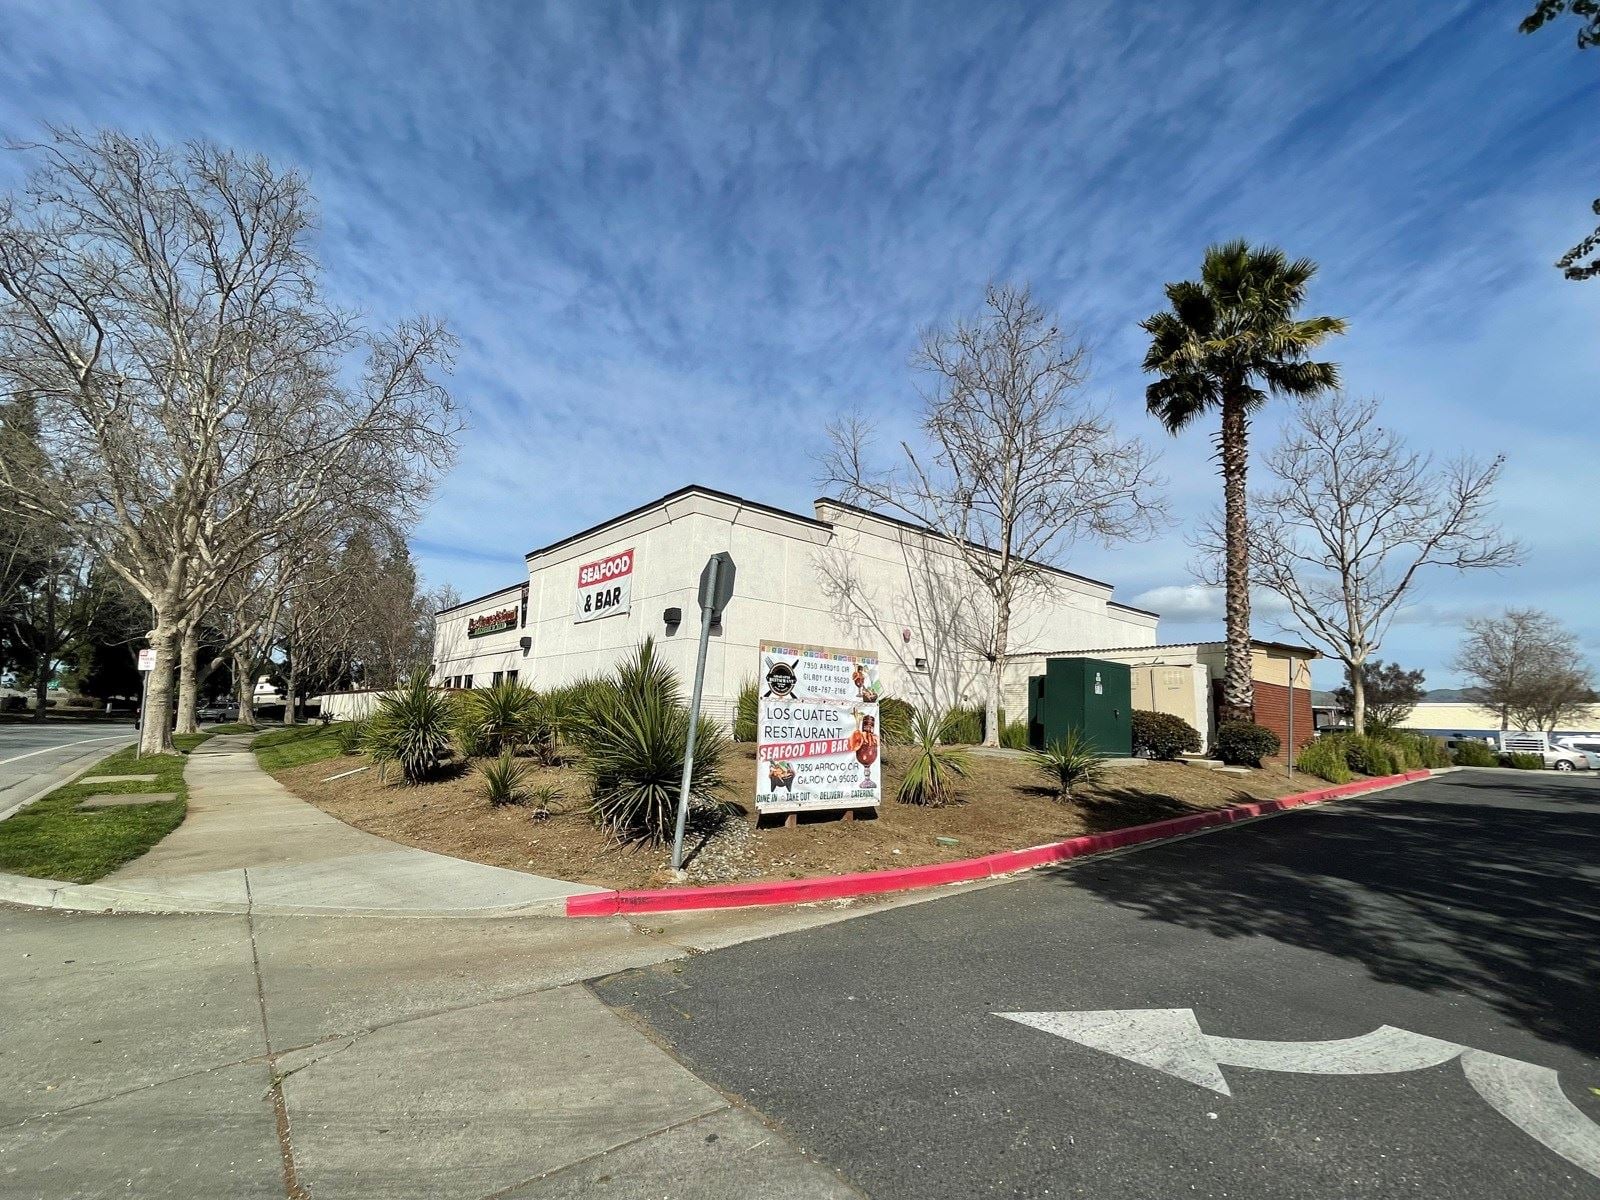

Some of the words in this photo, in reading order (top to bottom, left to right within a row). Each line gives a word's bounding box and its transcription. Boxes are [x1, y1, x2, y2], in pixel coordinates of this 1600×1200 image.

[581, 556, 630, 584] SEAFOOD
[584, 594, 592, 612] &
[595, 586, 621, 610] BAR
[803, 661, 818, 670] 7950
[819, 663, 840, 672] ARROYO
[841, 665, 850, 673] CIR
[803, 673, 822, 682] GILROY
[833, 676, 850, 685] 95020
[767, 707, 790, 720] LOS
[793, 708, 839, 722] CUATES
[764, 726, 843, 739] RESTAURANT
[760, 743, 806, 761] SEAFOOD
[808, 741, 828, 755] AND
[831, 739, 849, 752] BAR
[797, 763, 813, 772] 7950
[814, 762, 847, 771] ARROYO
[847, 762, 859, 771] CIR
[797, 775, 825, 785] GILROY
[827, 775, 838, 783] CA
[839, 775, 858, 783] 95020
[756, 794, 771, 803] DINE
[771, 794, 778, 802] IN
[786, 792, 799, 802] TAKE
[800, 791, 811, 801] OUT
[820, 791, 844, 800] DELIVERY
[850, 789, 874, 799] CATERING
